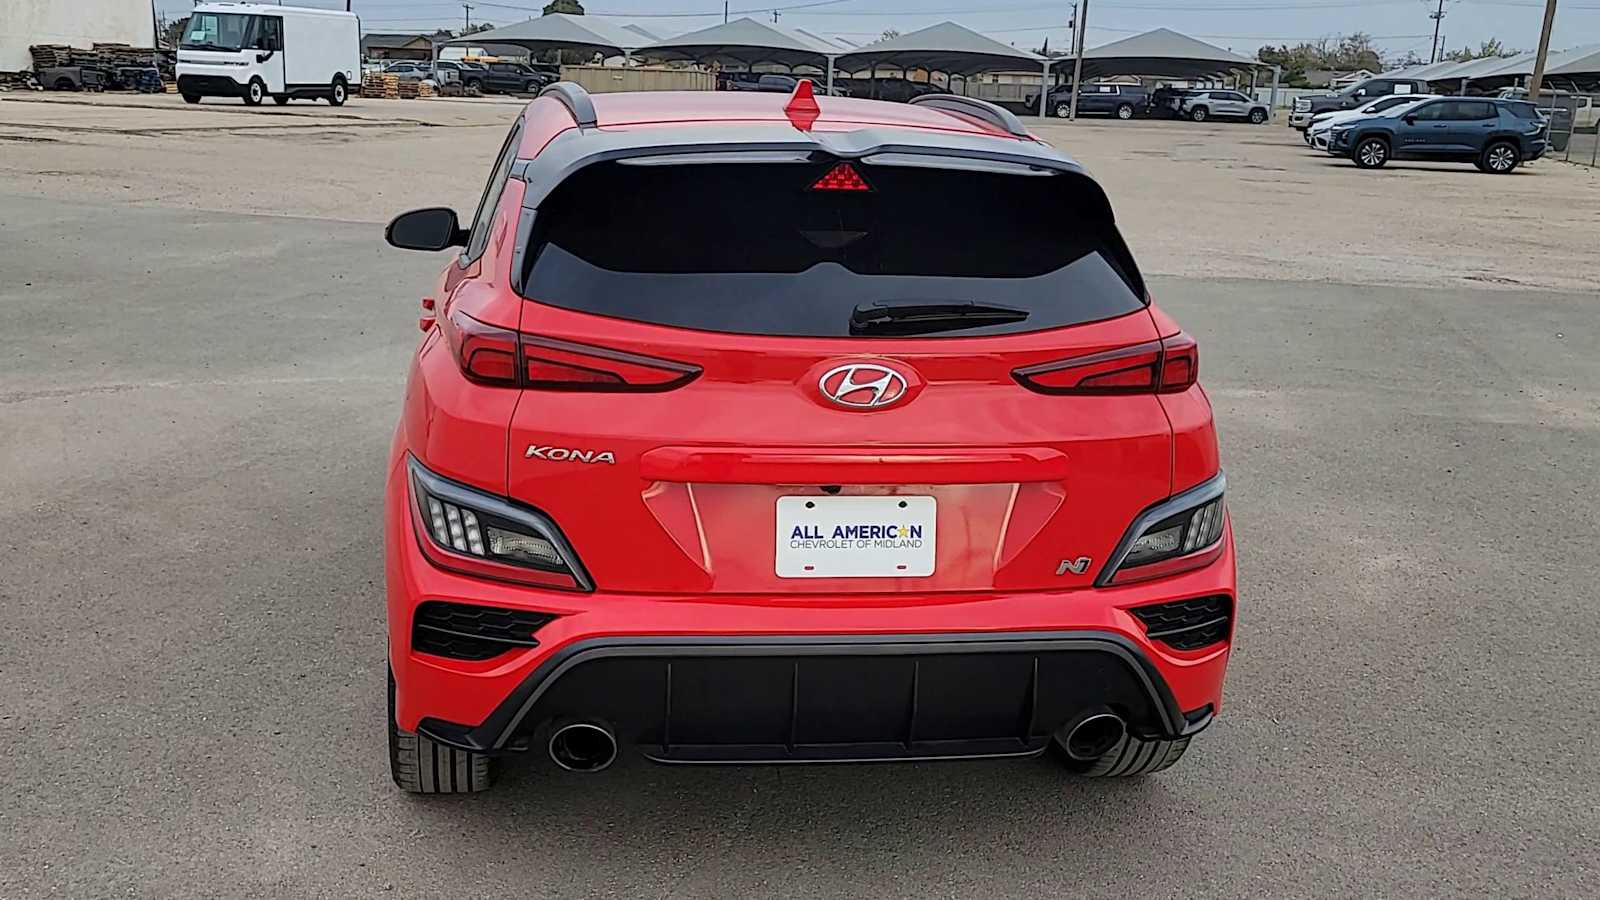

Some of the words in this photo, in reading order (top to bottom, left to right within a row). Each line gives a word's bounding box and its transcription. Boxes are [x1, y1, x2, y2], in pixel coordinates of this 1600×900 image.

[524, 444, 616, 465] KONA
[790, 525, 824, 539] ALL
[831, 525, 923, 539] AMERICN
[789, 539, 853, 549] CHEVROLET
[856, 539, 872, 549] OF
[873, 539, 923, 549] MIDLAND
